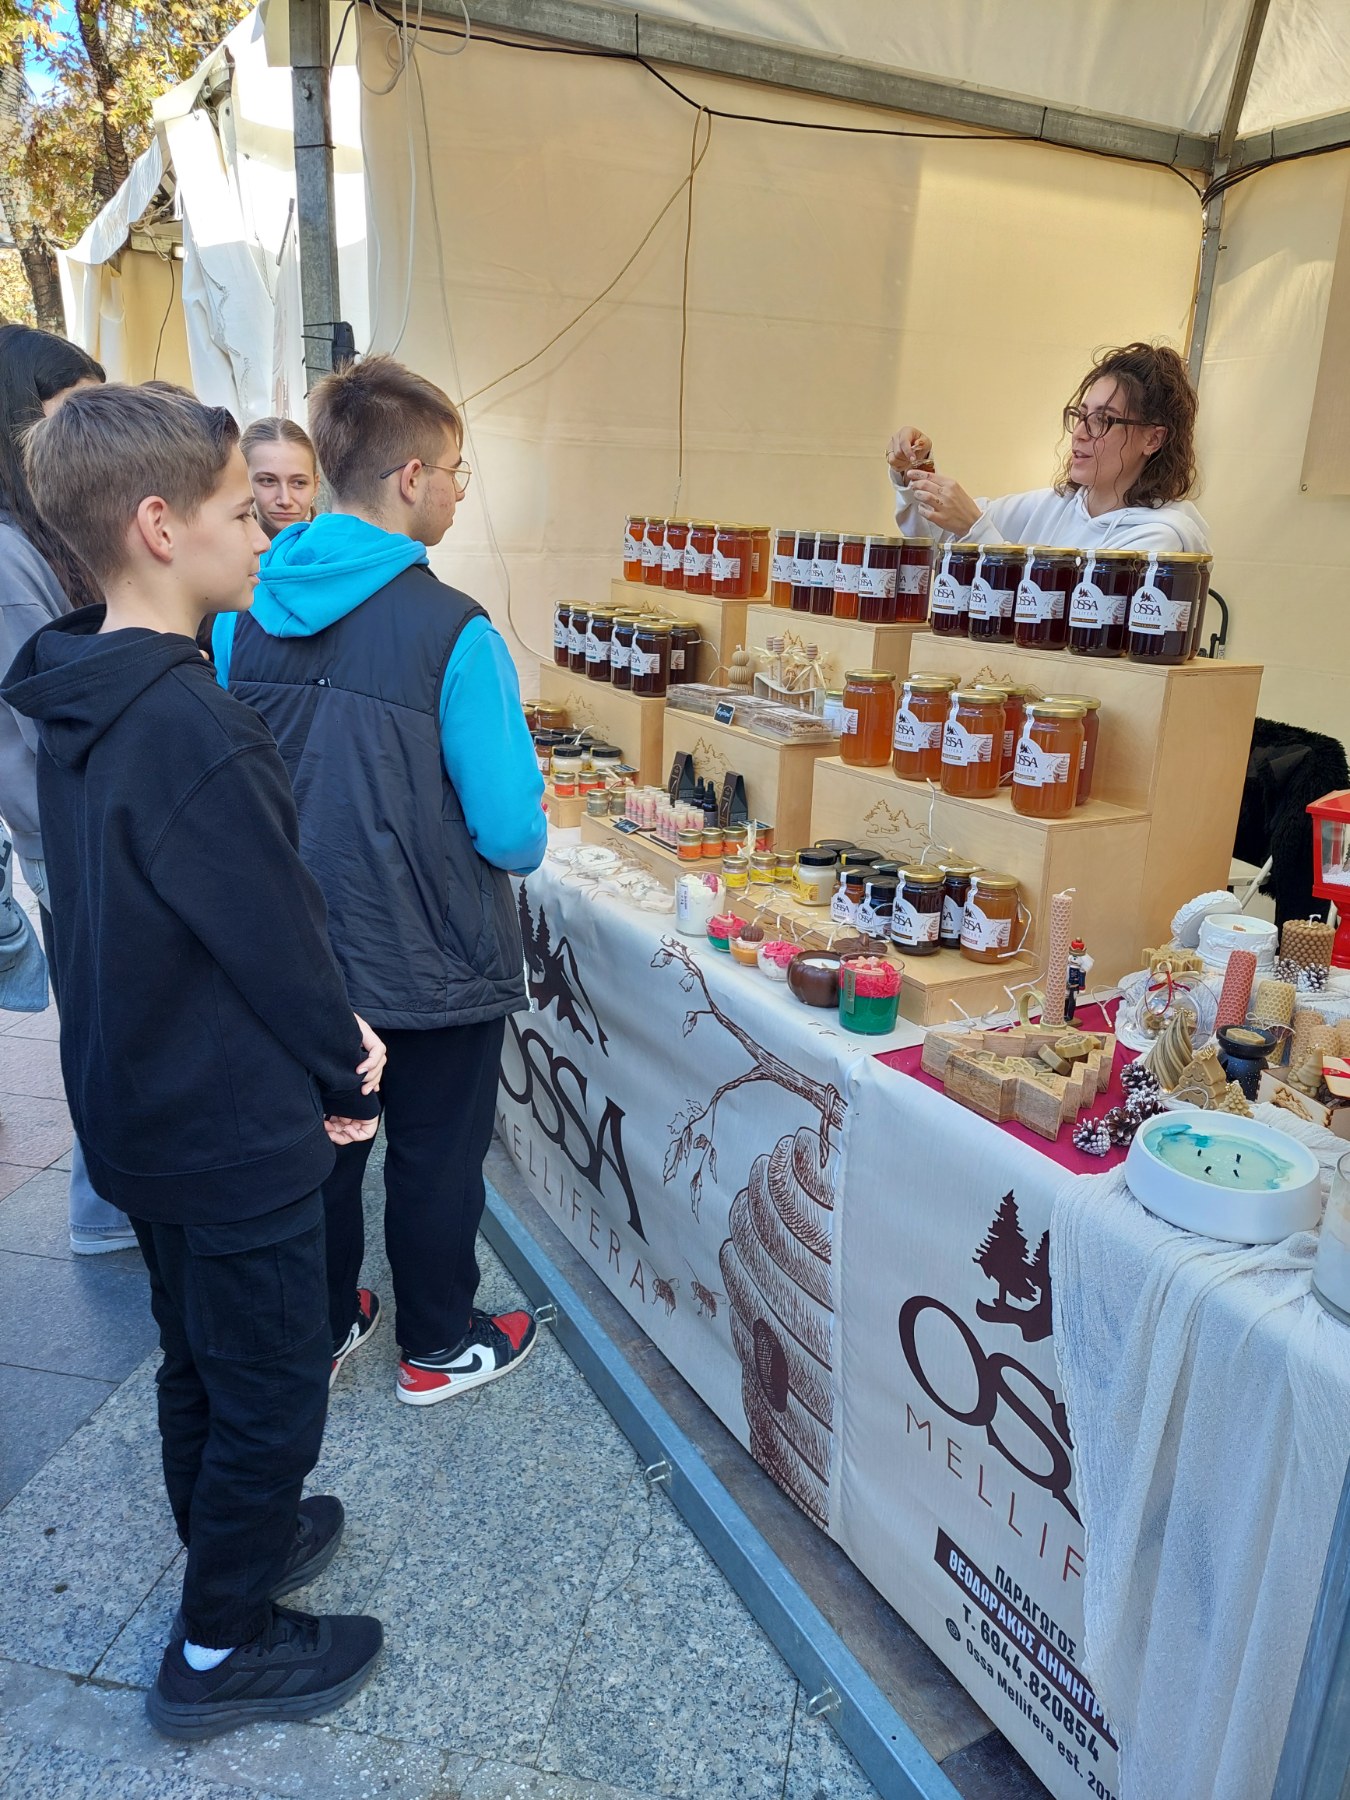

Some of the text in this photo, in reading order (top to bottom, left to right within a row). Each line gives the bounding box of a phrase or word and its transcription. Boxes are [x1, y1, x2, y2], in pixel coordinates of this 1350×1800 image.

[934, 587, 956, 600] OSSA
[1073, 599, 1099, 611] OSSA
[1133, 602, 1162, 616] OSSA
[948, 1550, 1035, 1655] ΘΕΟΔΩΡΑΚΗΣ
[995, 1565, 1077, 1663] ΠΑΡΑΓΩΓΟΣ
[966, 1638, 994, 1679] Ossa
[997, 1672, 1054, 1746] Mellifera
[1057, 1740, 1083, 1778] est.
[980, 1617, 1100, 1763] 6944.820854
